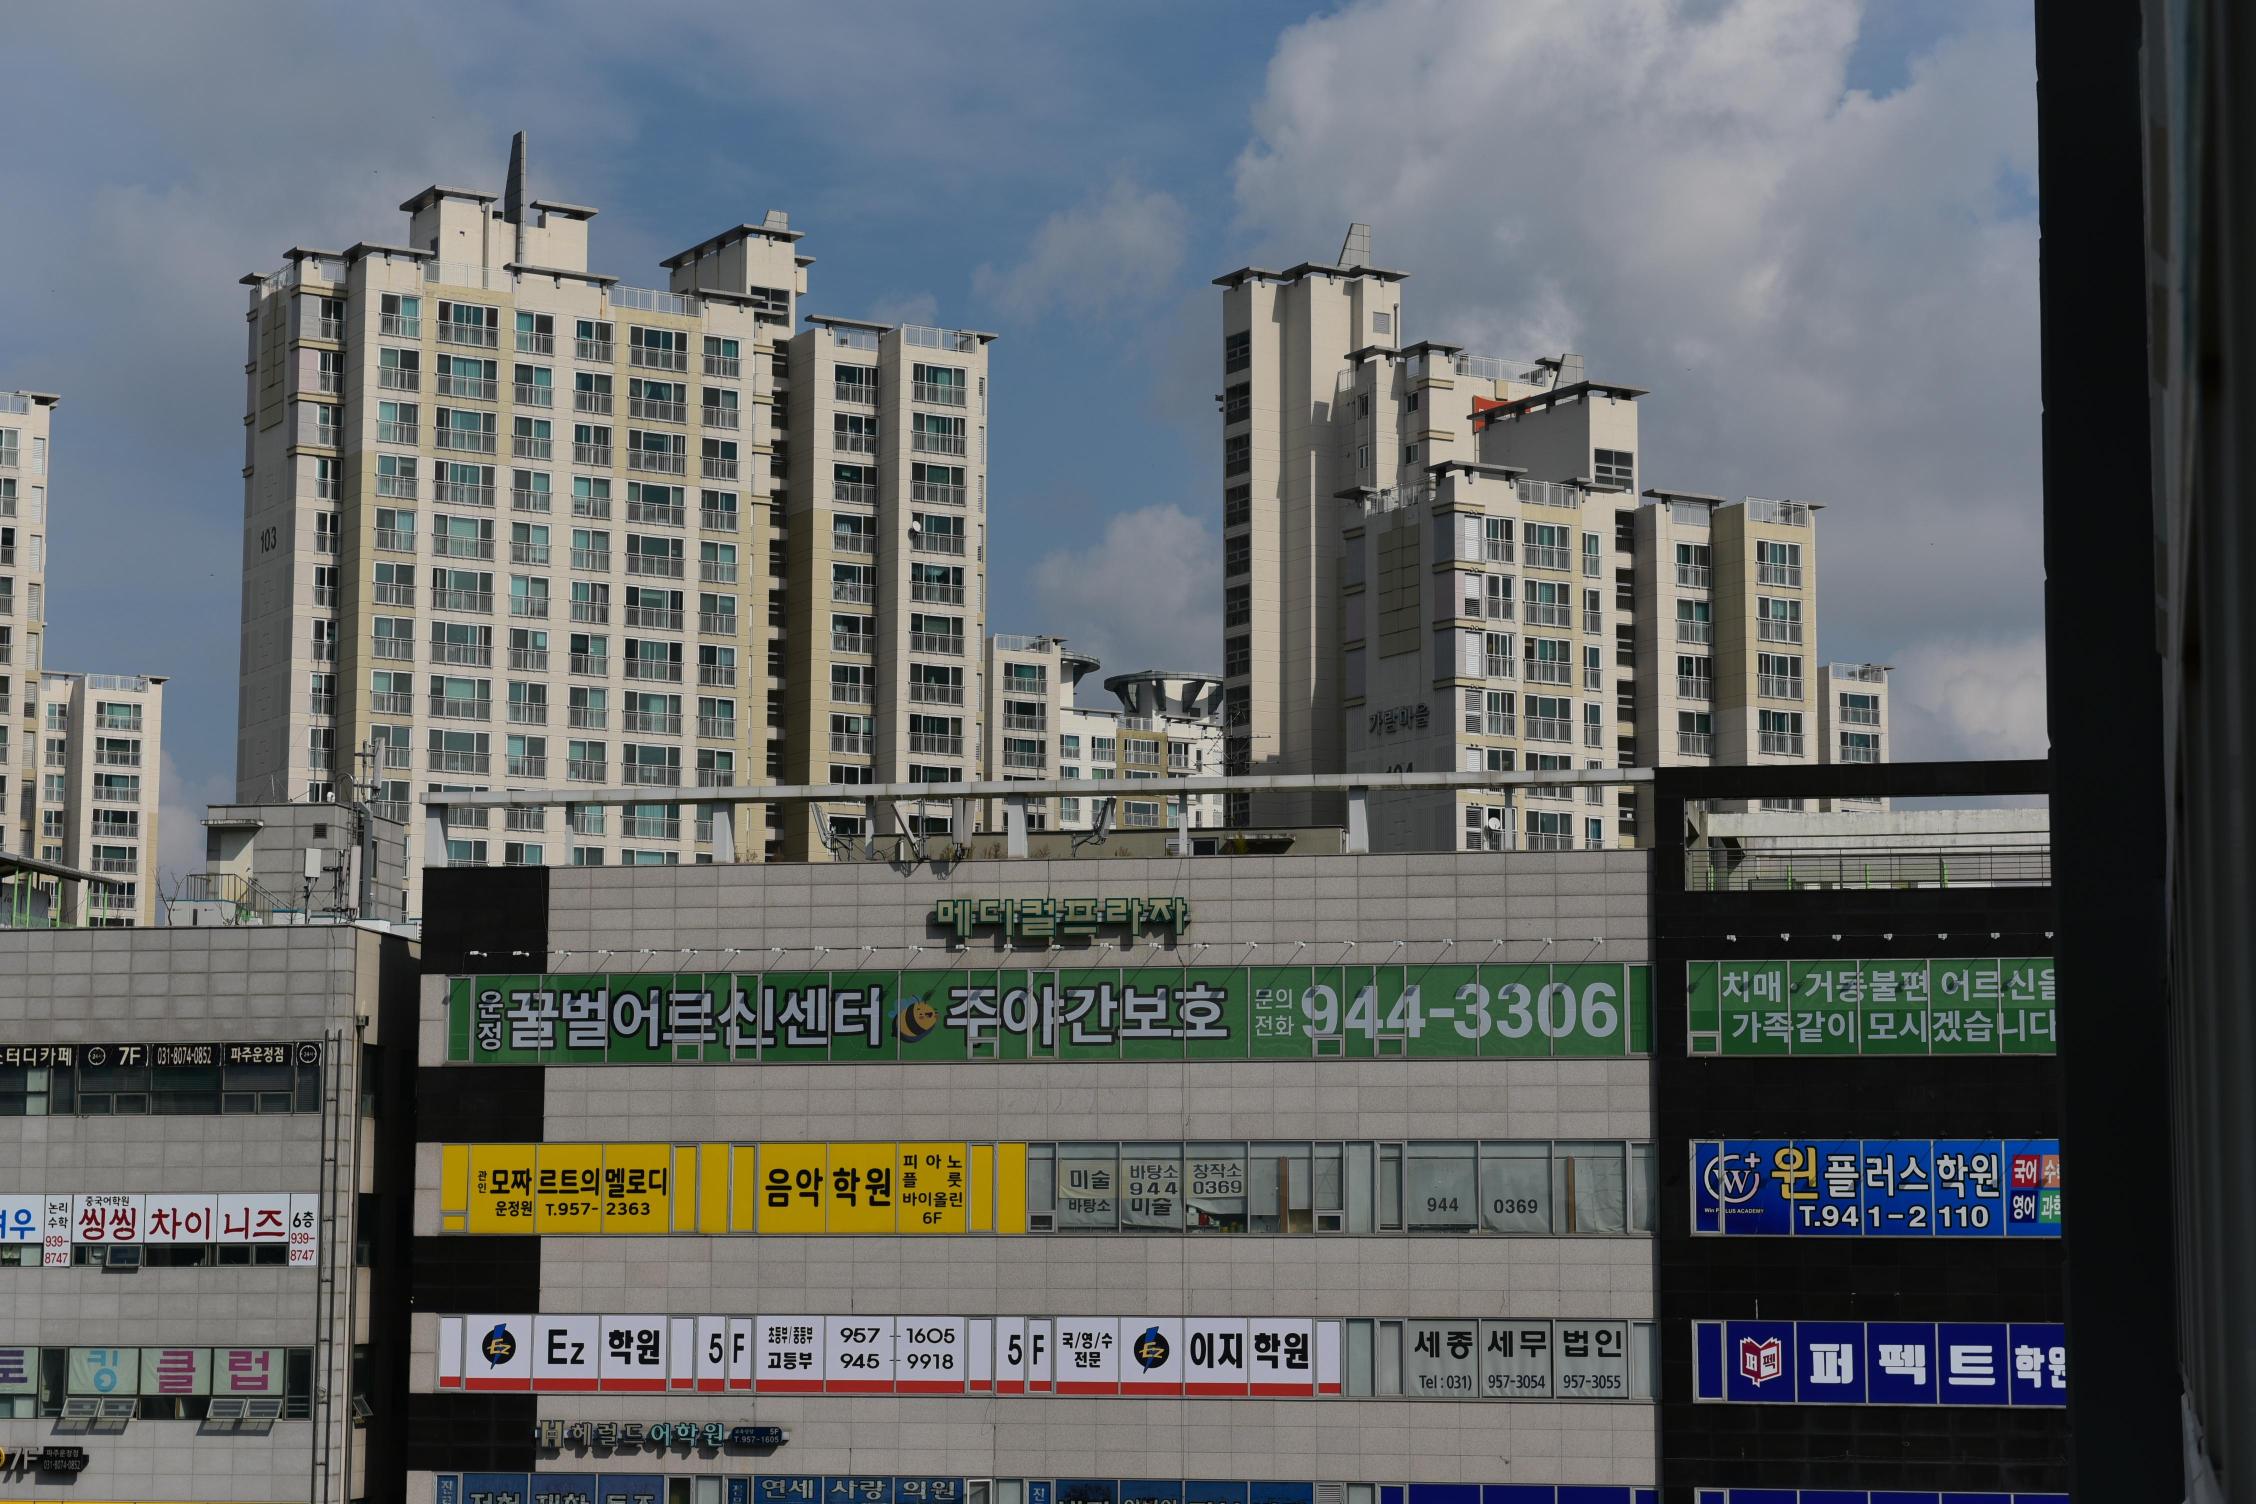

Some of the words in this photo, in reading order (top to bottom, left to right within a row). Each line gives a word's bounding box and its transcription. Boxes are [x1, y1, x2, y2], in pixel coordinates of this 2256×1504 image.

[261, 526, 277, 553] 103
[937, 897, 1187, 937] 메디컬프라자
[1722, 970, 1781, 1003] 치매
[1805, 971, 1928, 1003] 거동불편
[1255, 988, 1293, 1011] 문의
[478, 990, 503, 1050] 운정
[945, 985, 1229, 1044] 주야간보호
[1302, 983, 1618, 1039] 944-3306
[1255, 1015, 1294, 1037] 전화
[1732, 1011, 1855, 1043] 가족같이
[119, 1047, 141, 1065] 7F
[231, 1047, 285, 1063] 파주운정점
[1070, 1169, 1111, 1190] 미술
[1130, 1163, 1179, 1180] 바탕소
[1193, 1163, 1242, 1179] 창작소
[2014, 1159, 2037, 1183] 국어
[490, 1168, 600, 1196] 모짜르트의
[605, 1168, 667, 1198] 멜로디
[1130, 1182, 1178, 1195] 944
[1193, 1180, 1242, 1194] 0369
[48, 1202, 68, 1214] 논리
[85, 1196, 130, 1207] 중국어학원
[495, 1201, 533, 1217] 운정원
[902, 1192, 963, 1208] 바이올린
[1069, 1199, 1112, 1213] 바탕소
[1132, 1198, 1173, 1216] 미술
[1427, 1197, 1459, 1212] 944
[1493, 1199, 1538, 1214] 0369
[2012, 1195, 2035, 1219] 영어
[48, 1217, 69, 1229] 수학
[79, 1207, 137, 1240] 씽씽
[292, 1211, 315, 1228] 6층
[922, 1212, 943, 1225] 6F
[44, 1253, 68, 1264] 8747
[290, 1250, 315, 1261] 8747
[548, 1329, 585, 1364] Ez
[608, 1329, 660, 1365] 학원
[1254, 1332, 1309, 1369] 학원
[1415, 1330, 1473, 1359] 세종
[768, 1352, 813, 1370] 고등부
[1074, 1351, 1101, 1368] 전문
[1488, 1375, 1546, 1389] 957-3054
[1563, 1374, 1621, 1389] 957-3055
[761, 1479, 814, 1499] 연세
[831, 1479, 887, 1500] 사랑
[903, 1480, 956, 1500] 의원
